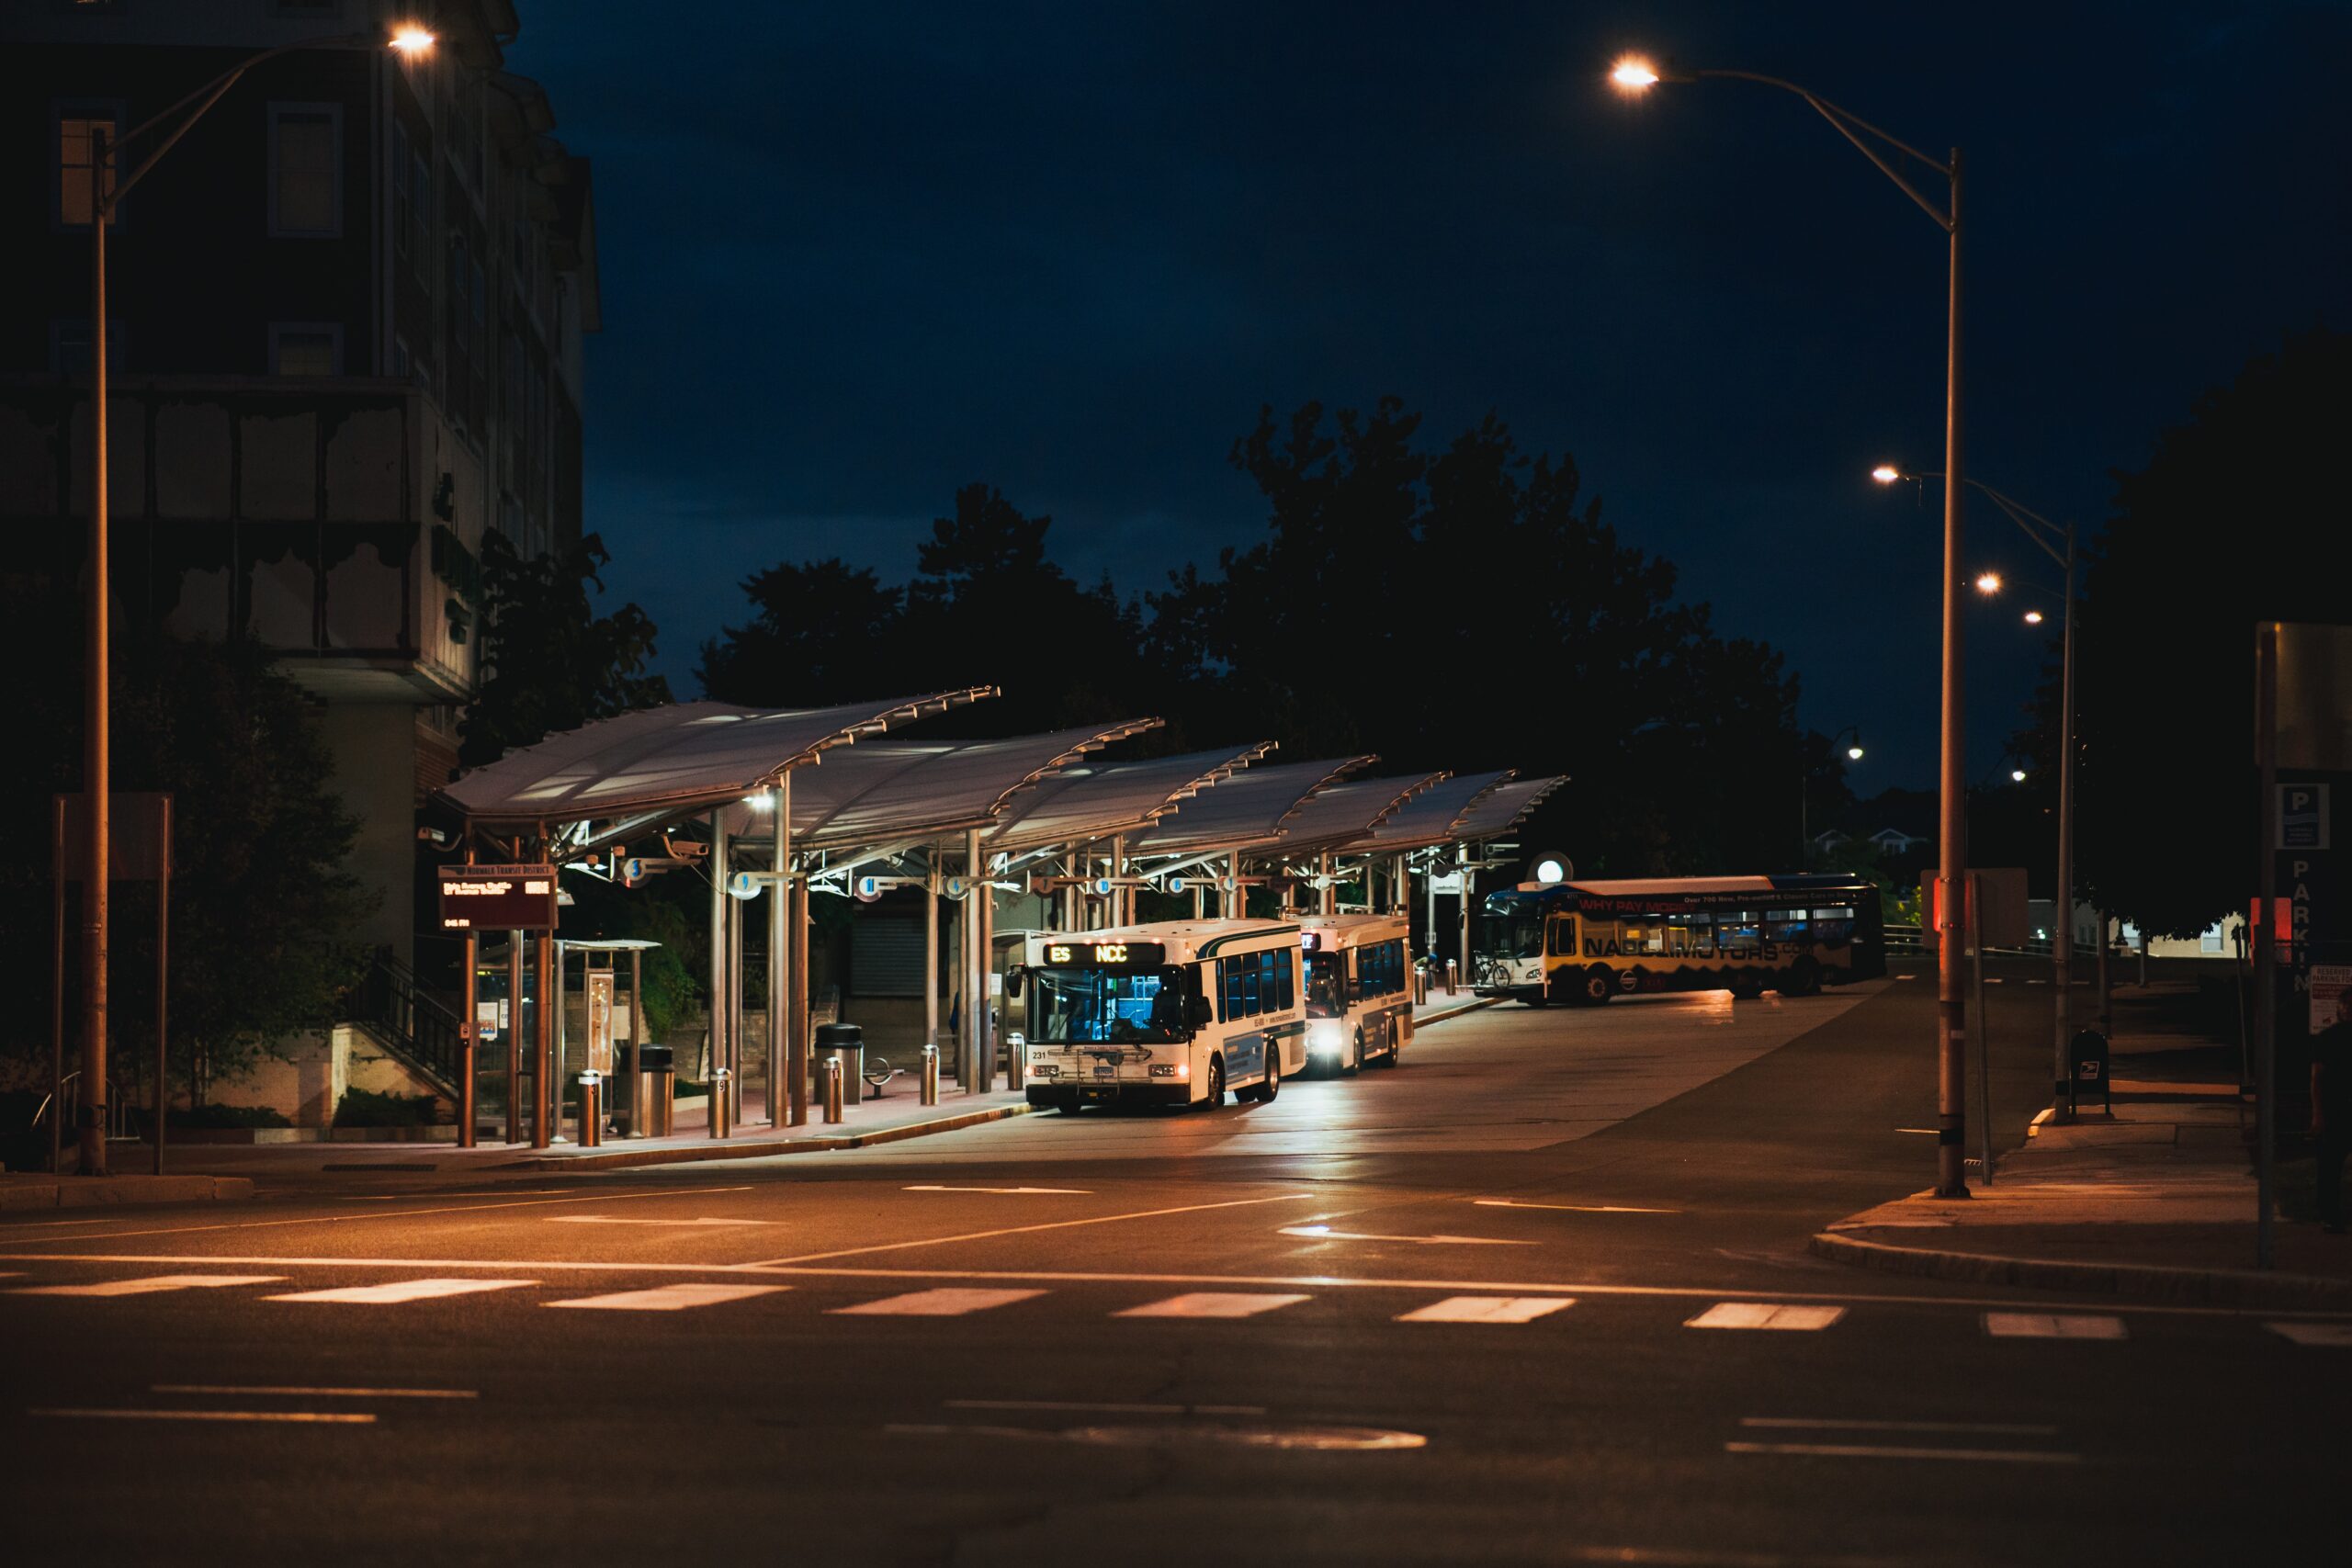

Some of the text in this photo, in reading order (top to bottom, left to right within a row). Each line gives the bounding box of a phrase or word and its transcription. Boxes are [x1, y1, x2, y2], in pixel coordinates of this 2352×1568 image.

[2292, 792, 2310, 810] P
[468, 865, 549, 874] NORWALK TRANSIT DISTRICT
[1579, 899, 1612, 911] WHY
[1616, 901, 1644, 912] PAY
[1051, 946, 1127, 963] ES NCC
[591, 1085, 596, 1095] 3
[719, 1081, 724, 1091] 9
